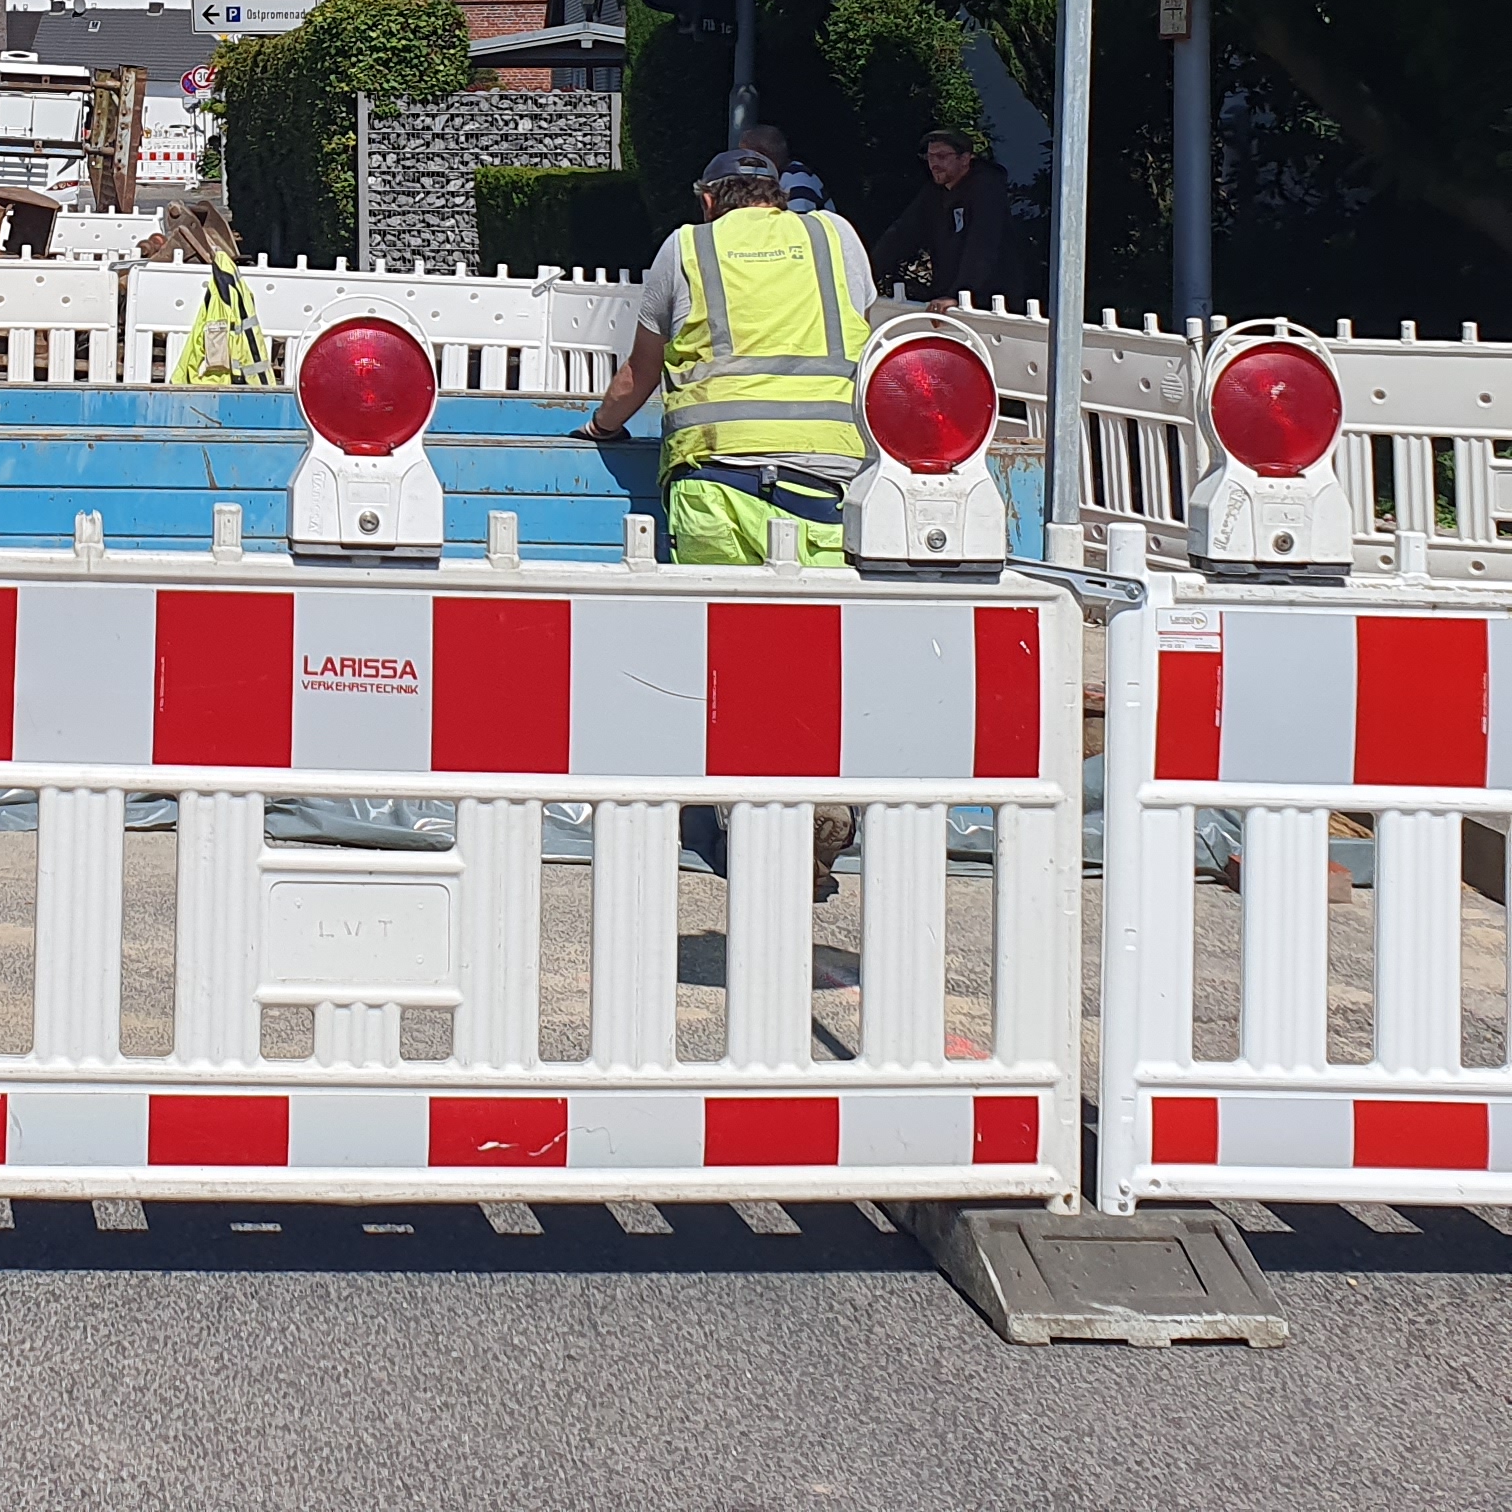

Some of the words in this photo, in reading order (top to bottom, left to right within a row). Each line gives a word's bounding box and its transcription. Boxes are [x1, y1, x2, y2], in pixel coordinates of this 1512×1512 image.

[228, 8, 238, 21] P
[246, 8, 307, 22] Ostpromenad
[303, 654, 418, 680] LARISSA
[301, 679, 419, 695] VERKEHRSTECHNIK
